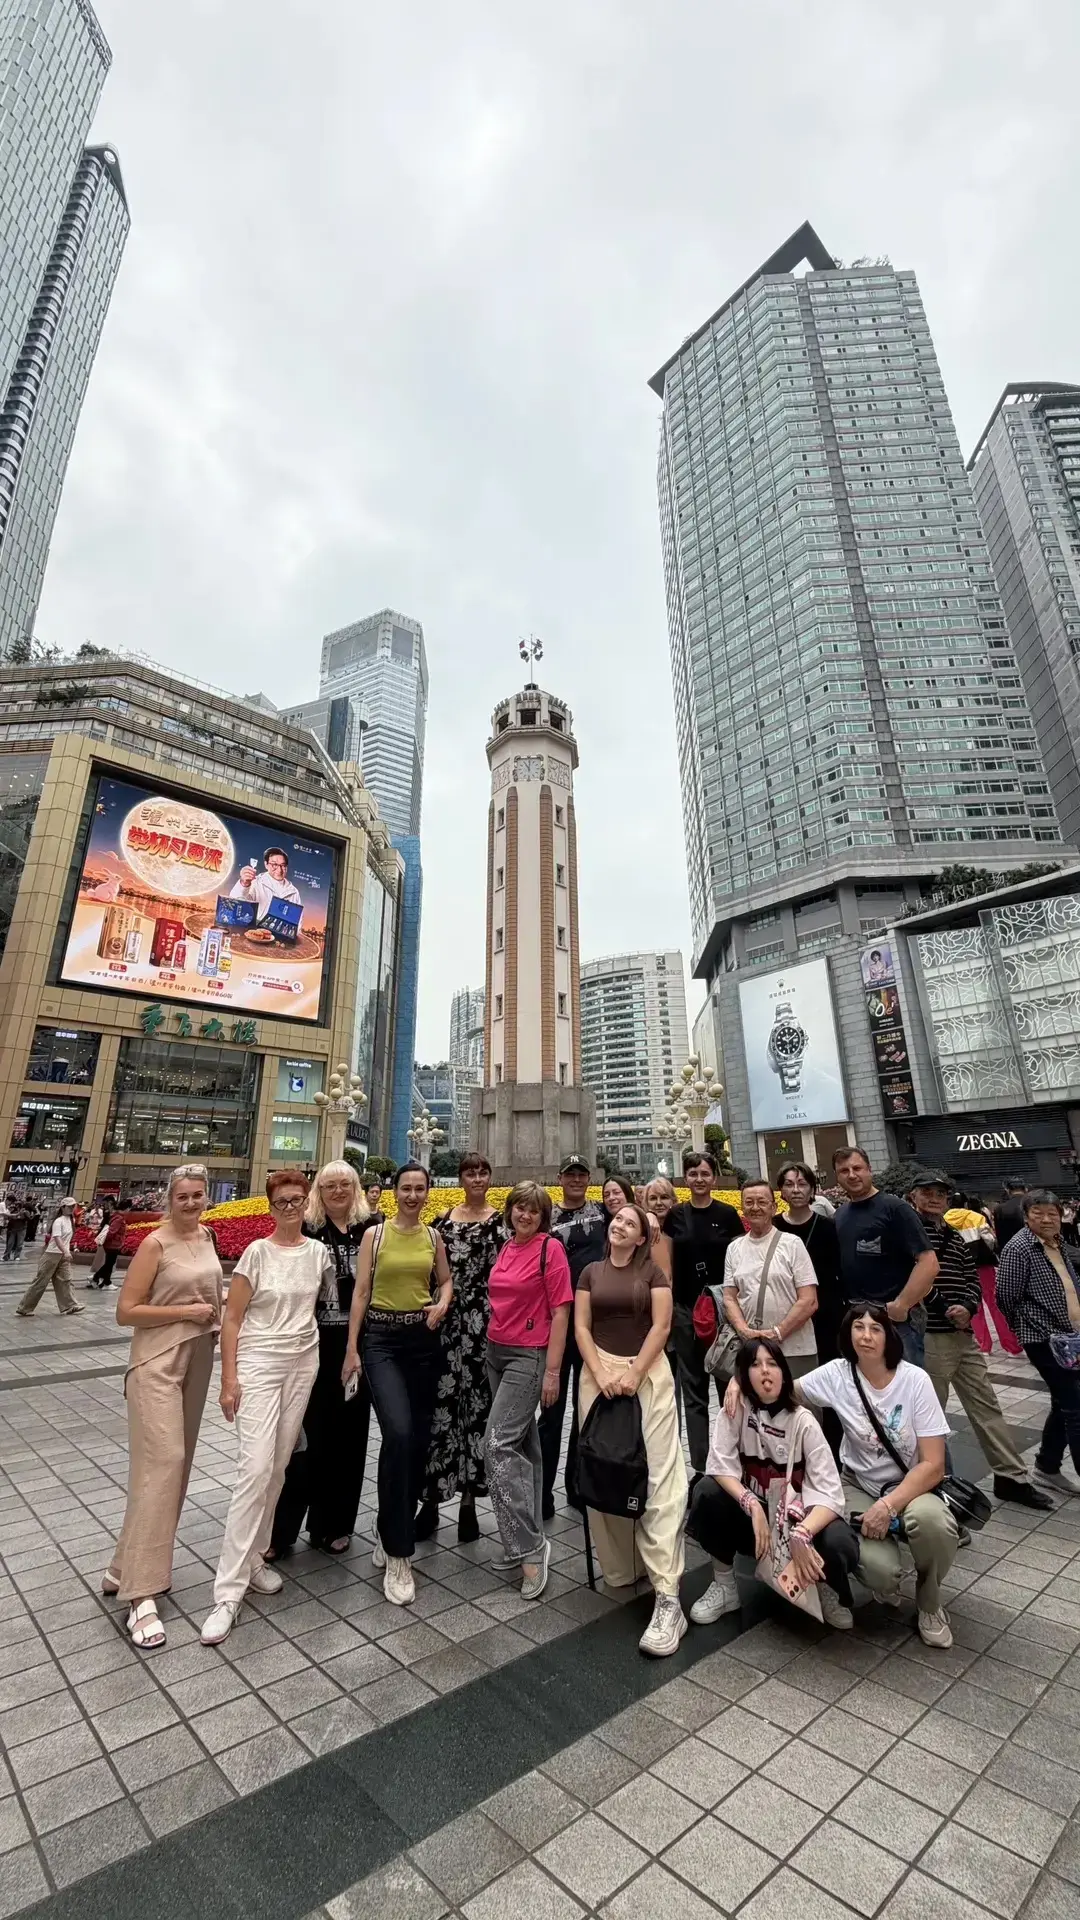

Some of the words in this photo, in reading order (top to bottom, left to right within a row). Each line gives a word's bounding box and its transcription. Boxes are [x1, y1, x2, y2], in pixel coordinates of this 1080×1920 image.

[127, 825, 223, 872] 举杯月更浓
[899, 871, 1005, 915] 重庆时代广场
[786, 1112, 807, 1120] ROLEX
[350, 1123, 369, 1140] LAUDER
[957, 1131, 1022, 1151] ZEGNA
[8, 1163, 60, 1174] LANCÔME
